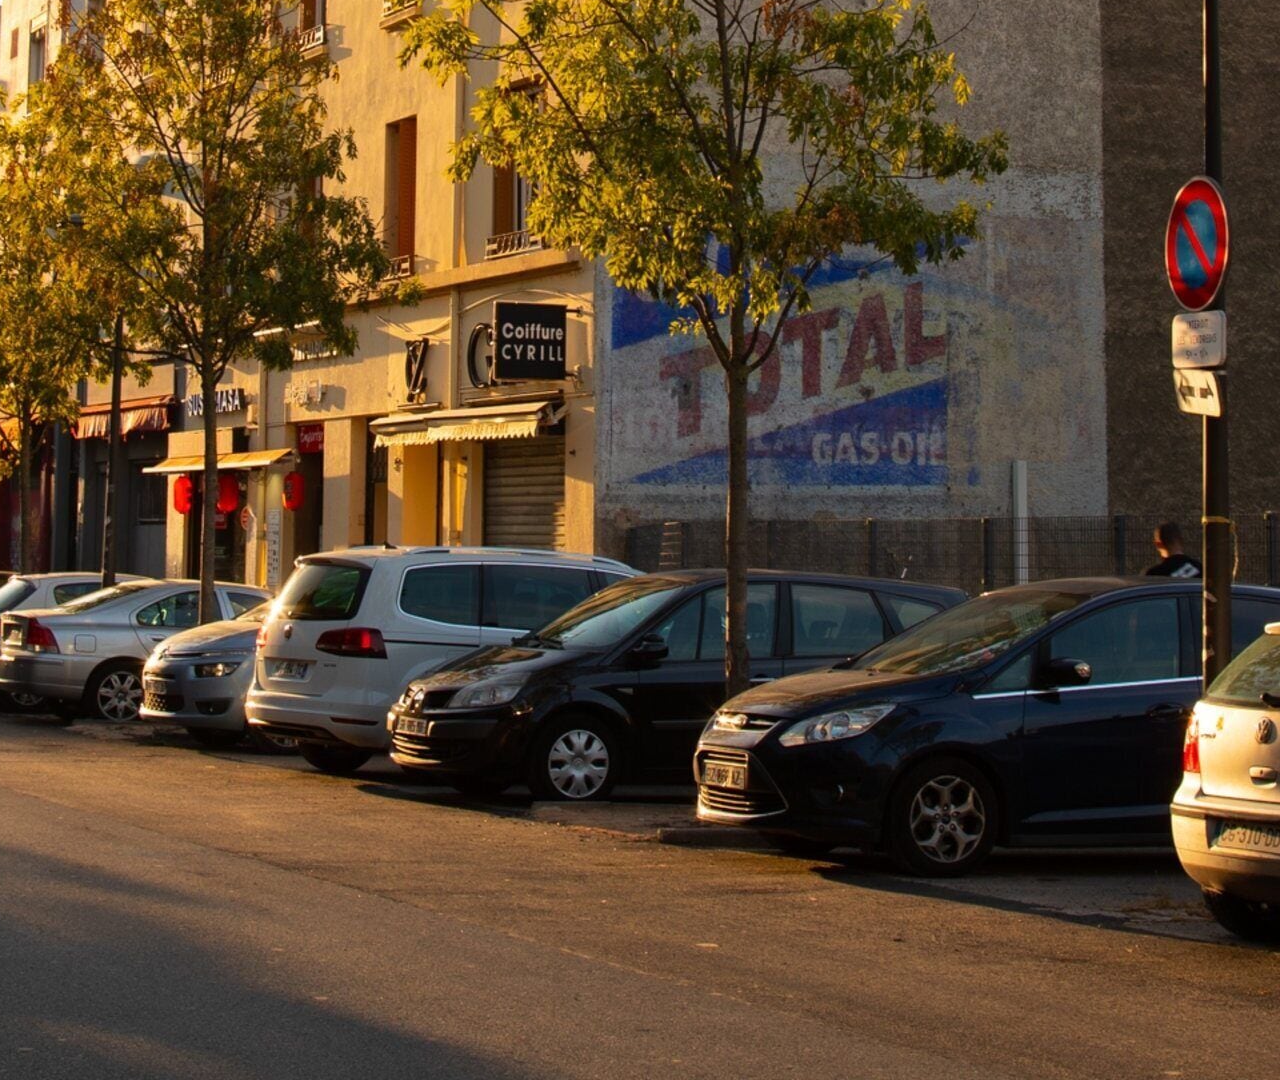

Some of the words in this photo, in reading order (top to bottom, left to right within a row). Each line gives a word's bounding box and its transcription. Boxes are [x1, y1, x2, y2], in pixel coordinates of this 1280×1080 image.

[501, 322, 564, 341] Coiffure
[501, 343, 564, 362] CYRILL
[658, 280, 949, 440] TOTAL
